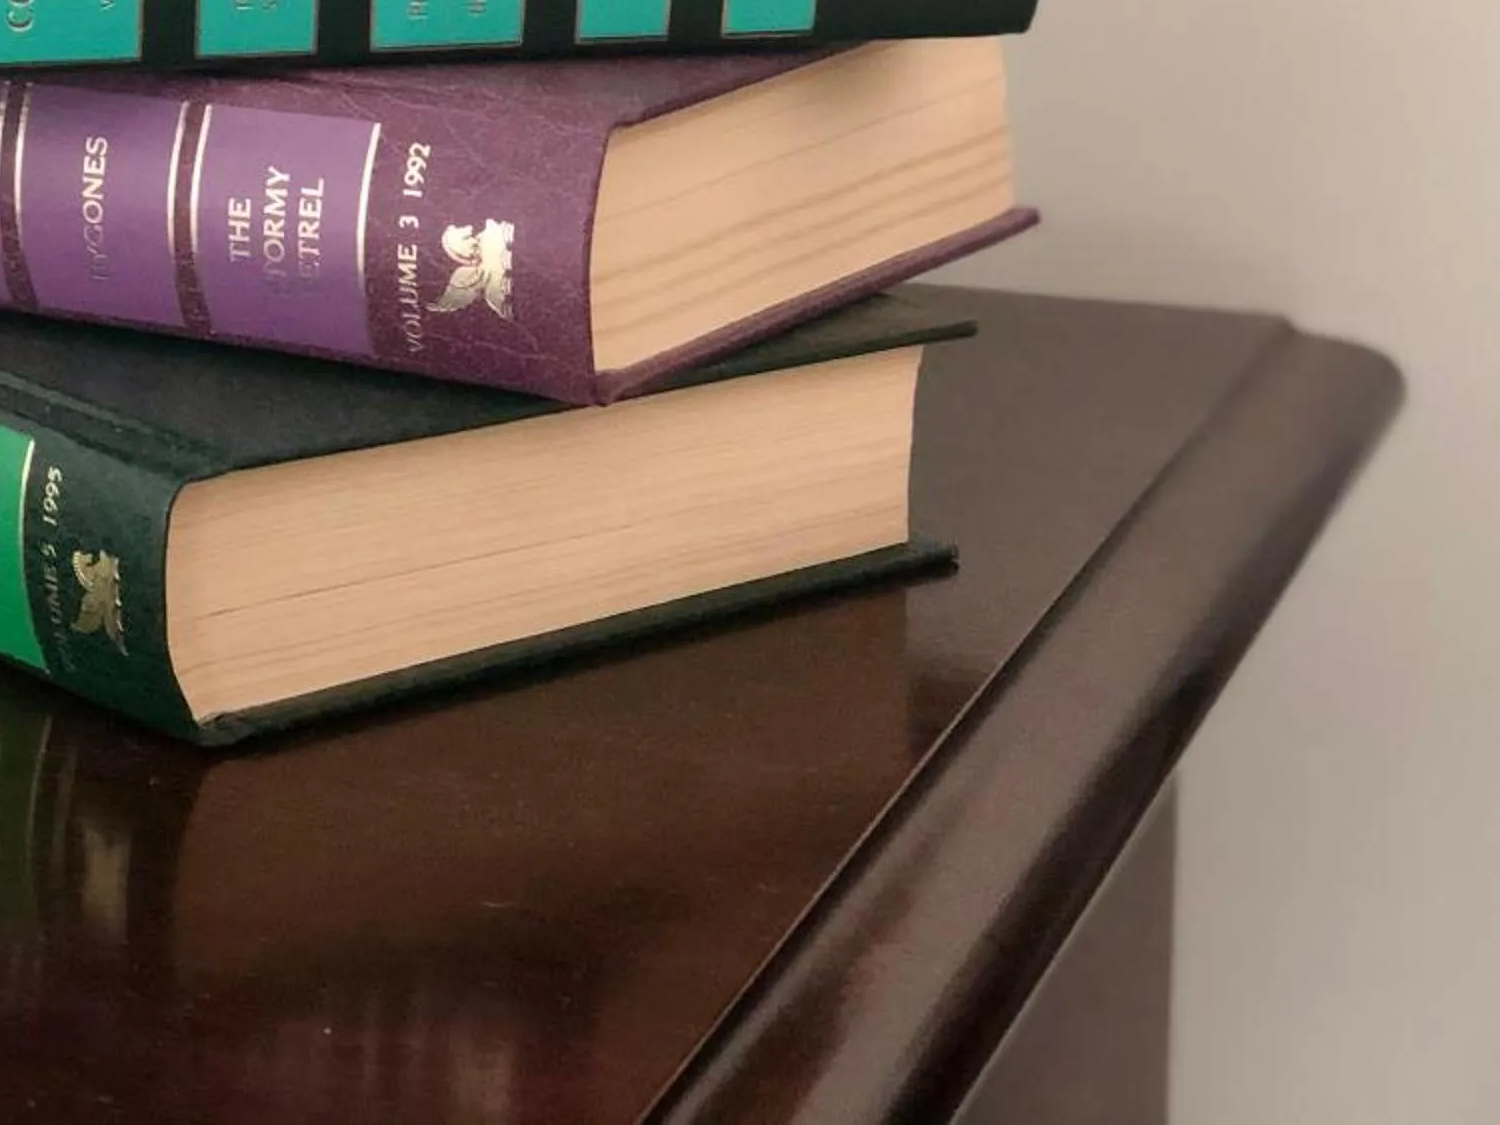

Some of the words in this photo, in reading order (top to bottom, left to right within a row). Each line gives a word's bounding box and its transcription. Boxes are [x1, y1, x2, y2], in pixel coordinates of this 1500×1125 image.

[402, 142, 432, 199] 1992
[228, 196, 252, 263] THE
[263, 165, 292, 289] TORMY
[297, 177, 326, 291] ETREL
[400, 215, 420, 230] 3
[397, 242, 422, 354] VOLUME
[41, 466, 64, 527] 1995
